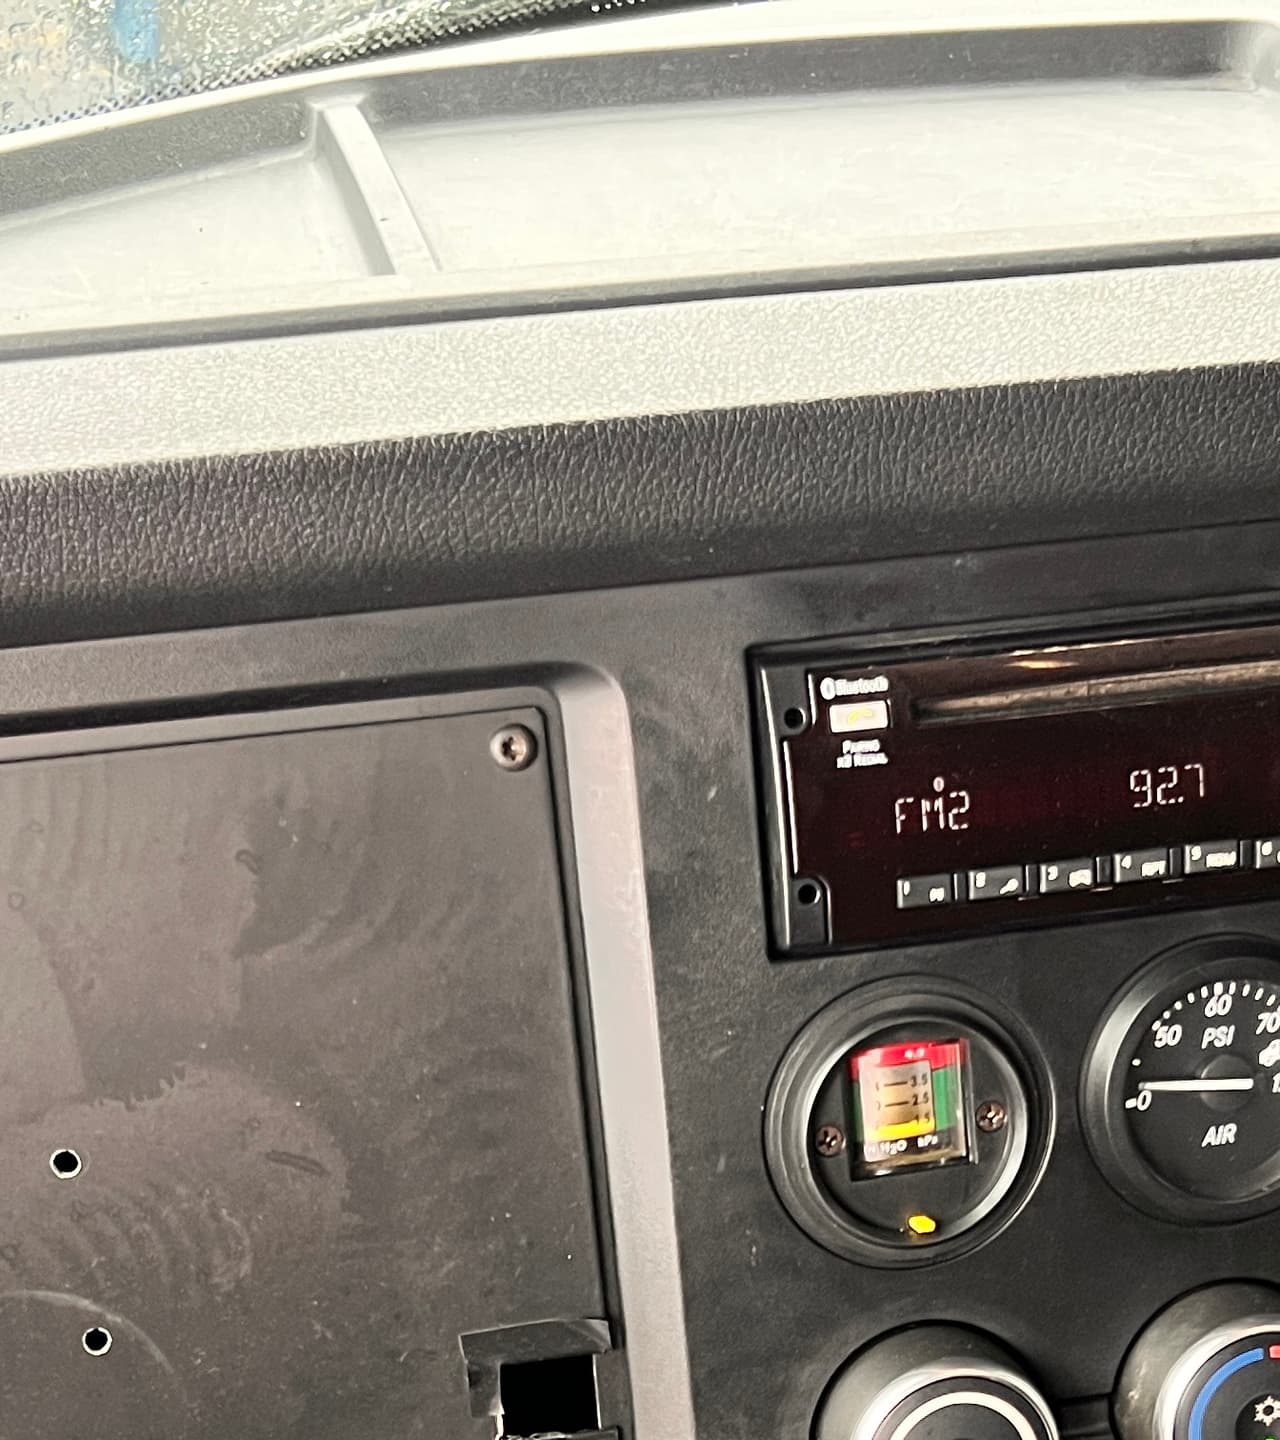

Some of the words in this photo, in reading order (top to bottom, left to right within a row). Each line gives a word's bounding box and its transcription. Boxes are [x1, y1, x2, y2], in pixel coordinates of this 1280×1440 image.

[894, 791, 970, 833] FM2
[1129, 763, 1205, 808] 92.7
[1204, 993, 1232, 1017] 60
[1154, 1024, 1182, 1048] 50
[1202, 1025, 1235, 1049] PSI
[910, 1073, 928, 1088] 3.5
[911, 1091, 929, 1106] 2.5
[1136, 1090, 1152, 1111] 0
[1202, 1123, 1237, 1147] AIR
